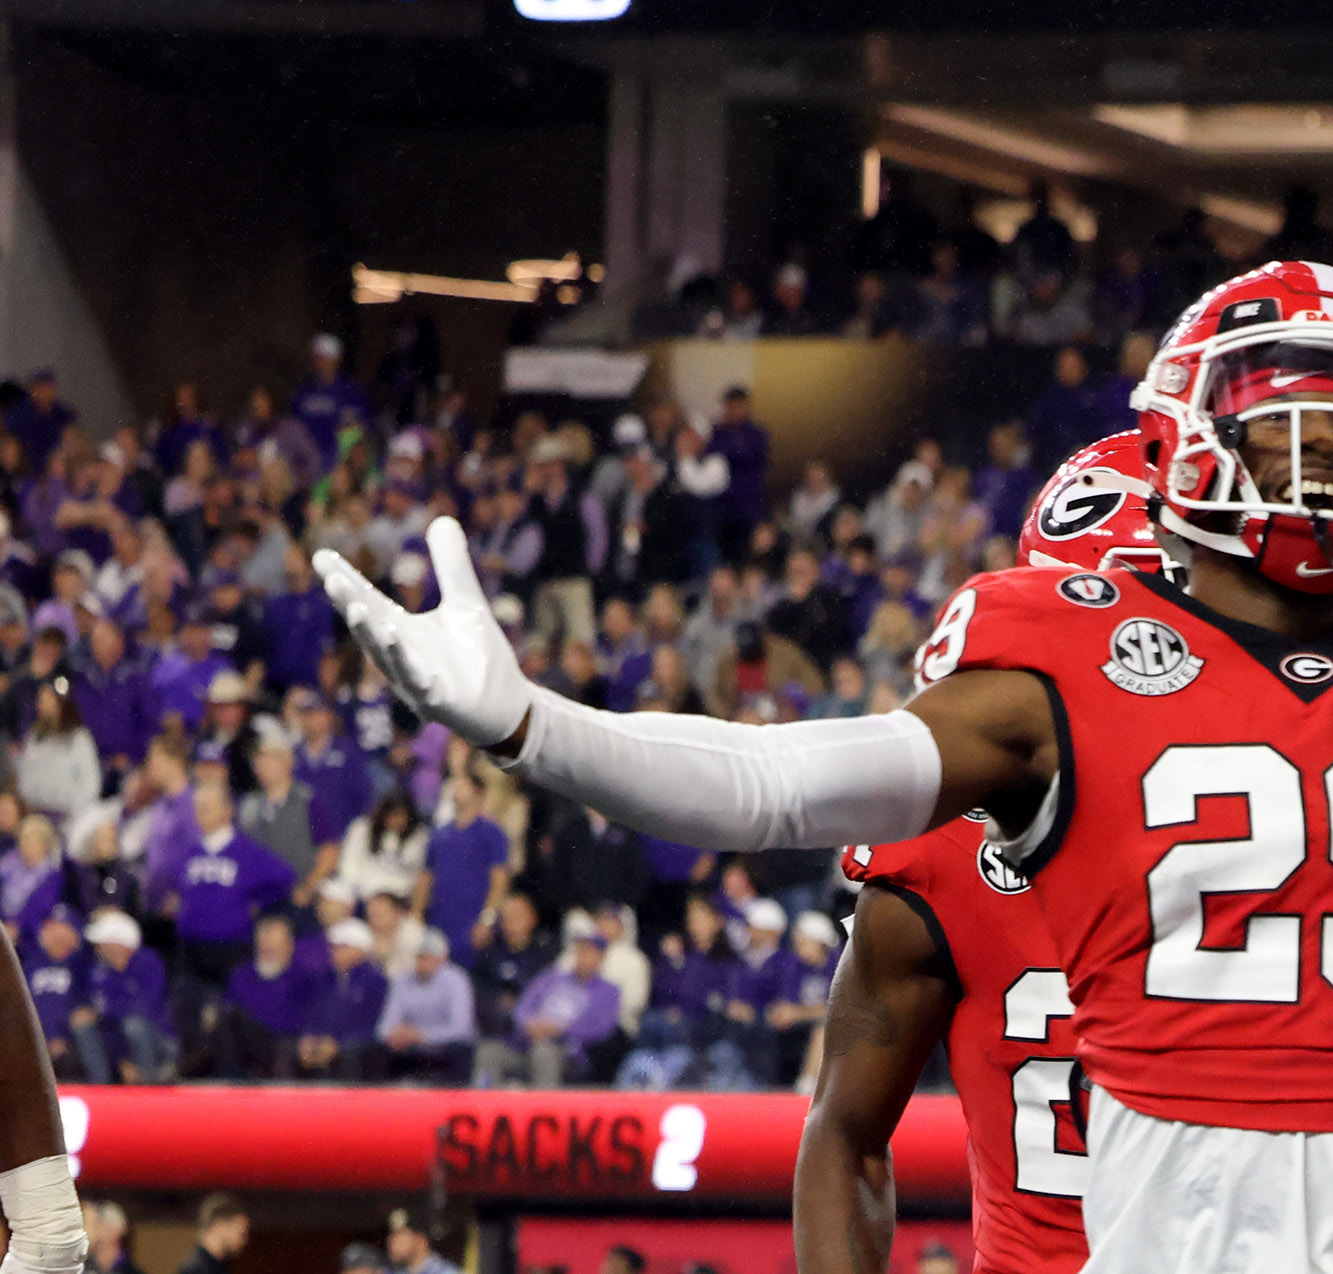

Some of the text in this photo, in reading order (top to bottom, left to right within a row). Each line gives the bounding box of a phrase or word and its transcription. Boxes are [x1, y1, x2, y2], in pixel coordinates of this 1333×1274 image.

[1115, 619, 1185, 677] SEC
[1114, 668, 1195, 693] GRADUATE
[443, 1104, 706, 1191] SACKS 2
